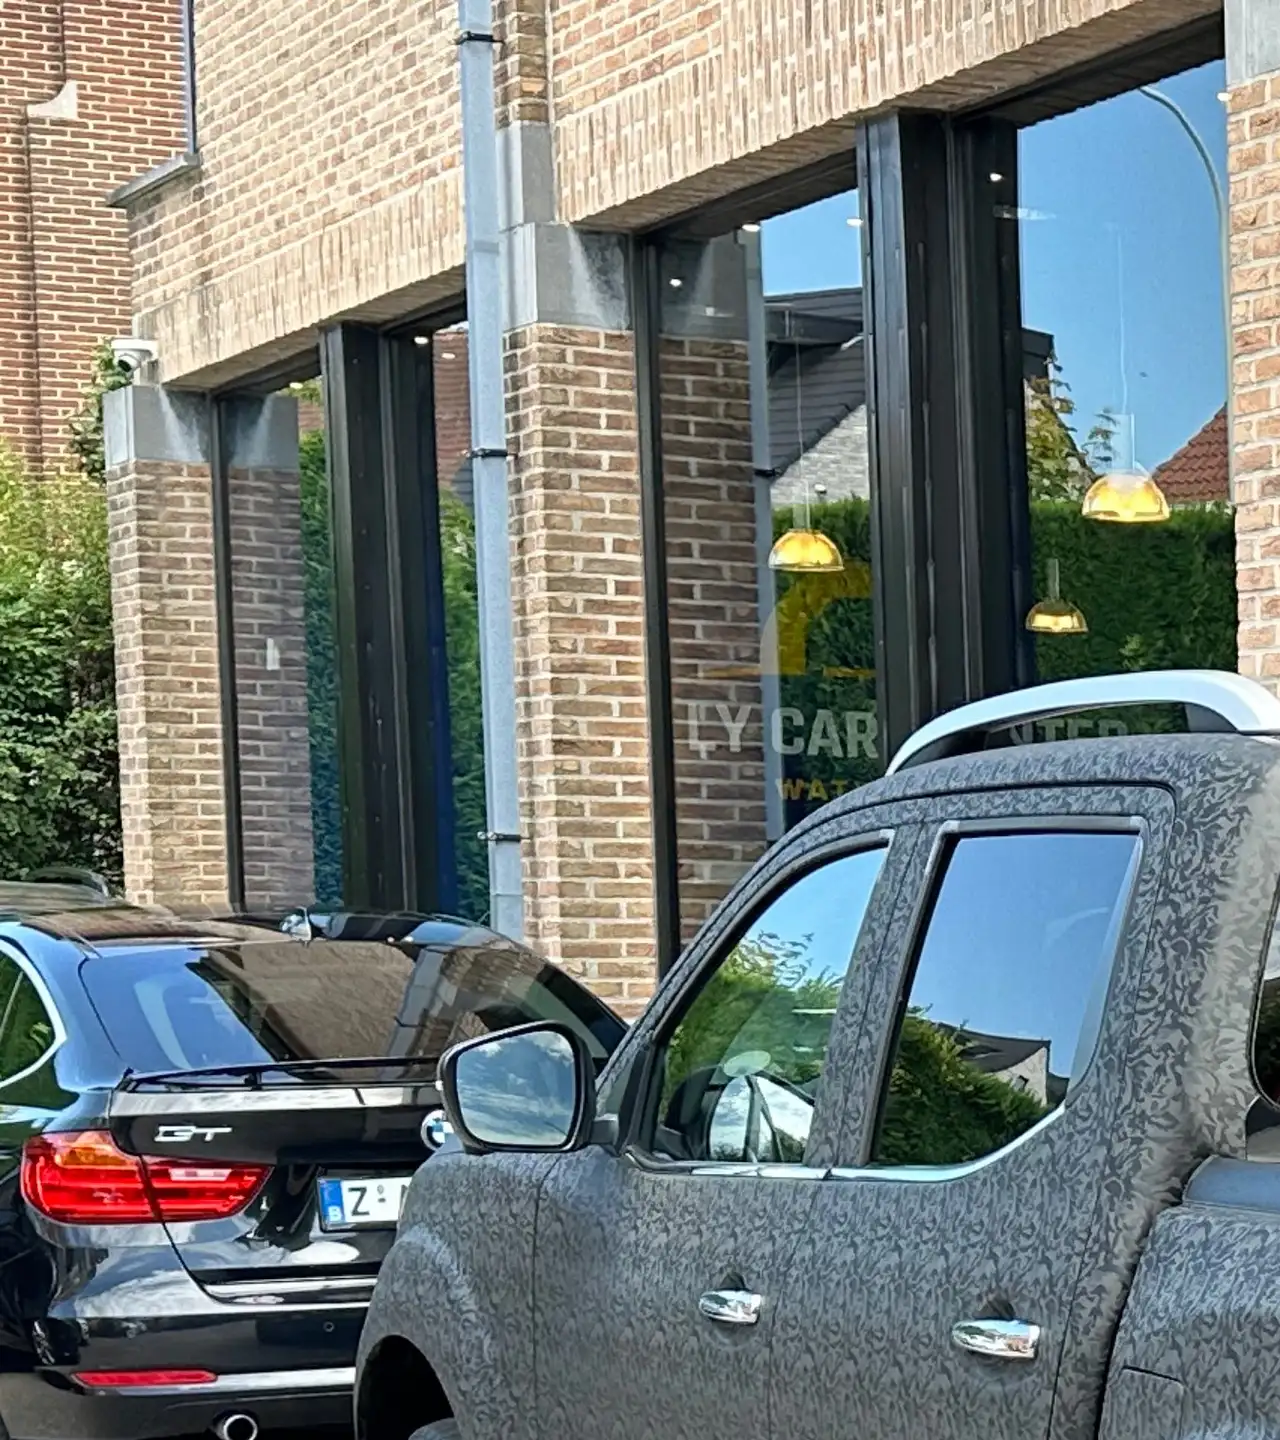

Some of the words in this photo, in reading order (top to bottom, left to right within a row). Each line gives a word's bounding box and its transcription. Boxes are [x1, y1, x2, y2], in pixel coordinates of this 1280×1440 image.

[688, 702, 752, 753] LY
[770, 707, 880, 759] CAR
[154, 1125, 232, 1142] GT
